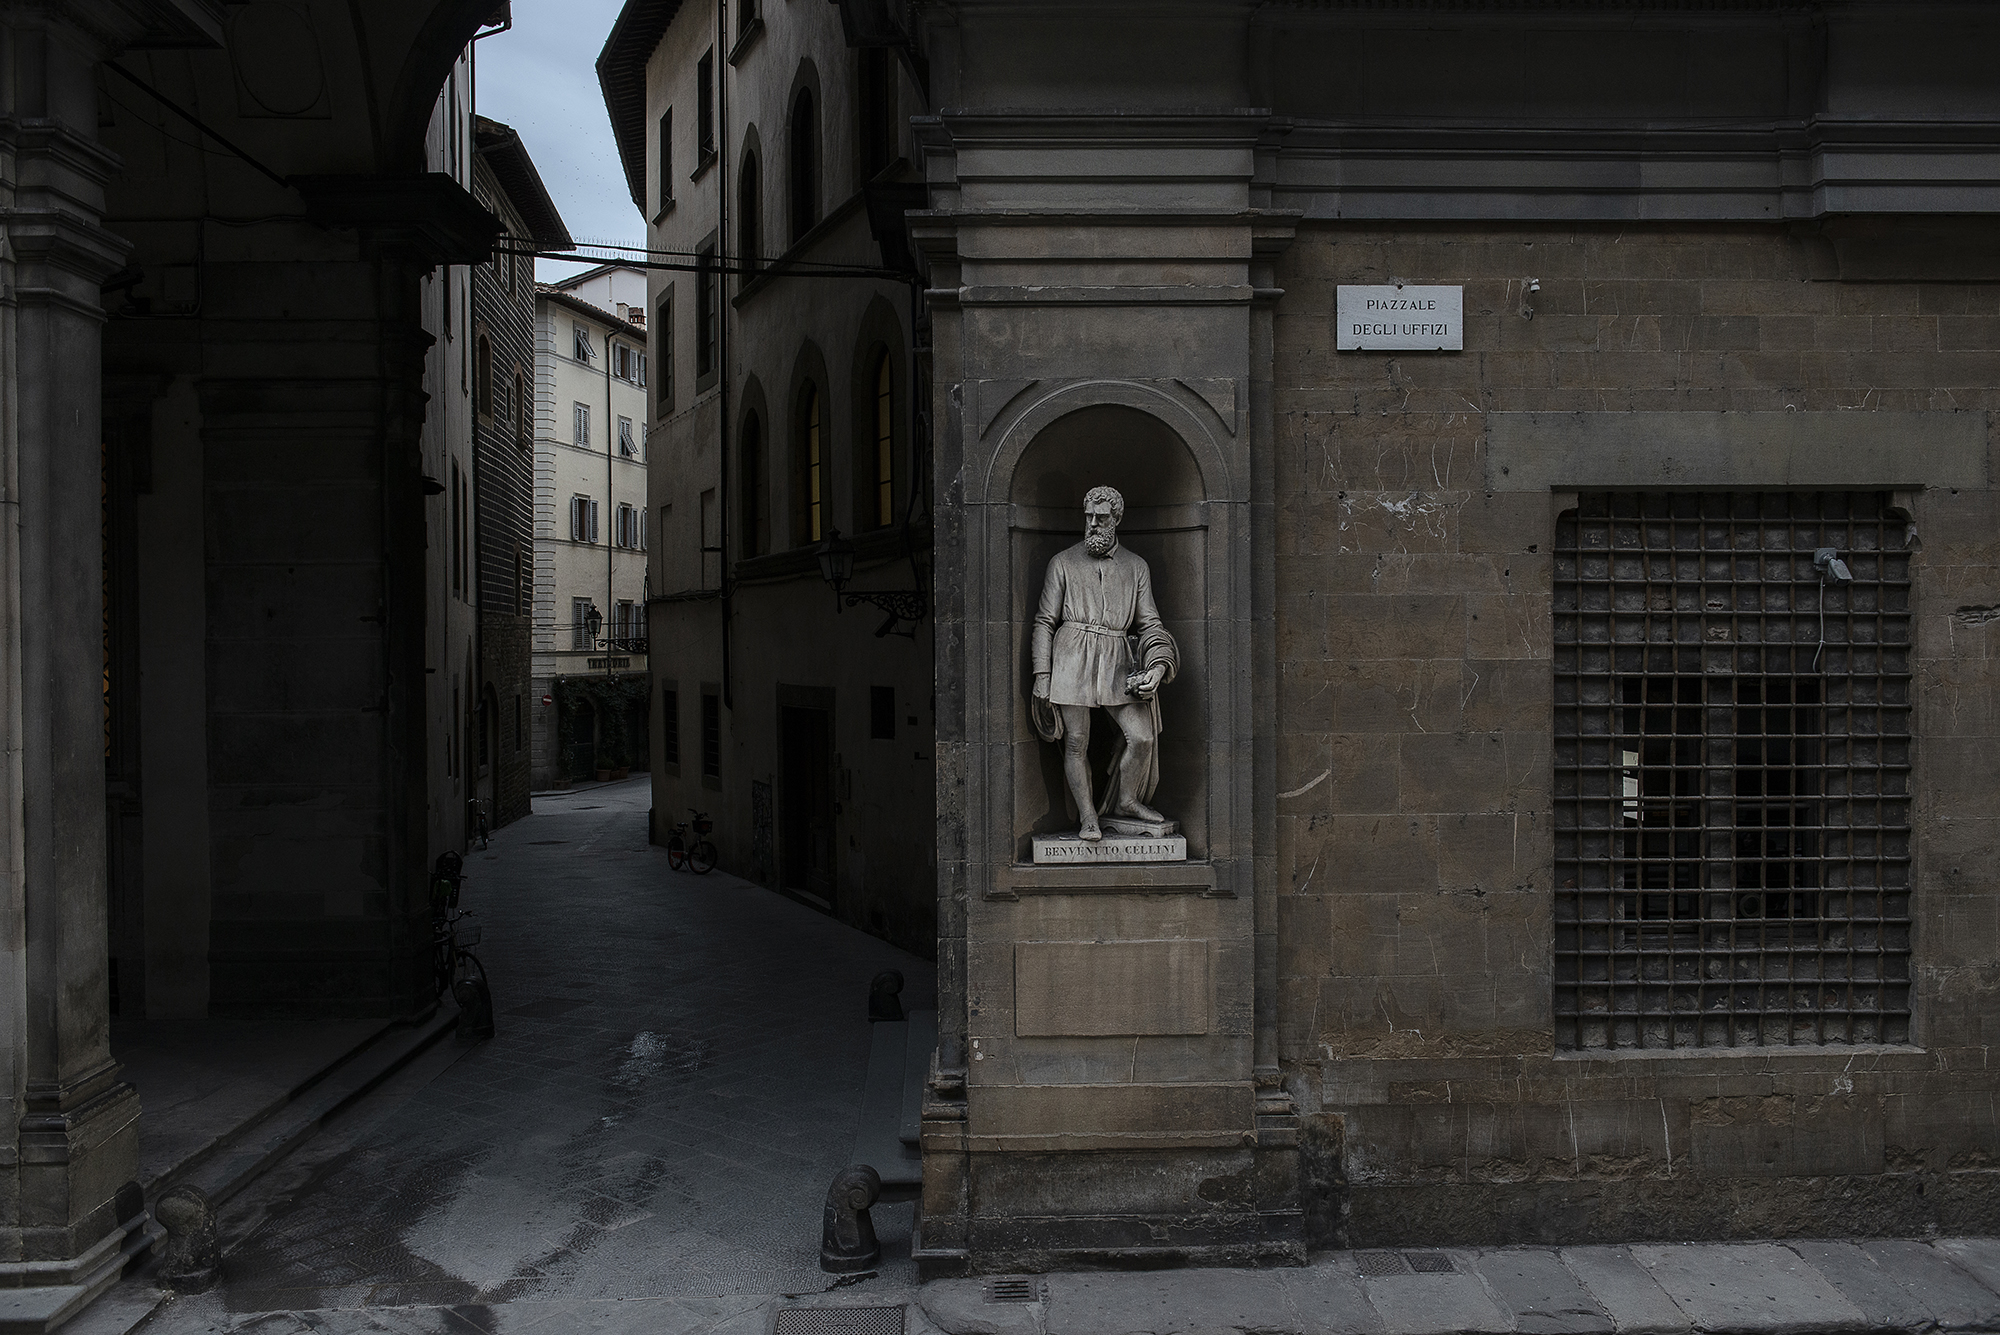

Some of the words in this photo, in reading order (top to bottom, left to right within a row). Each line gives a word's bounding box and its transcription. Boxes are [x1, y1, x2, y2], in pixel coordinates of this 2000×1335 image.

[1366, 300, 1436, 310] PIAZZALE
[1353, 324, 1397, 335] DEGLI
[1402, 324, 1448, 335] UFFIZI
[1044, 846, 1119, 857] BENVENUTO
[1125, 845, 1175, 855] CELLINI
